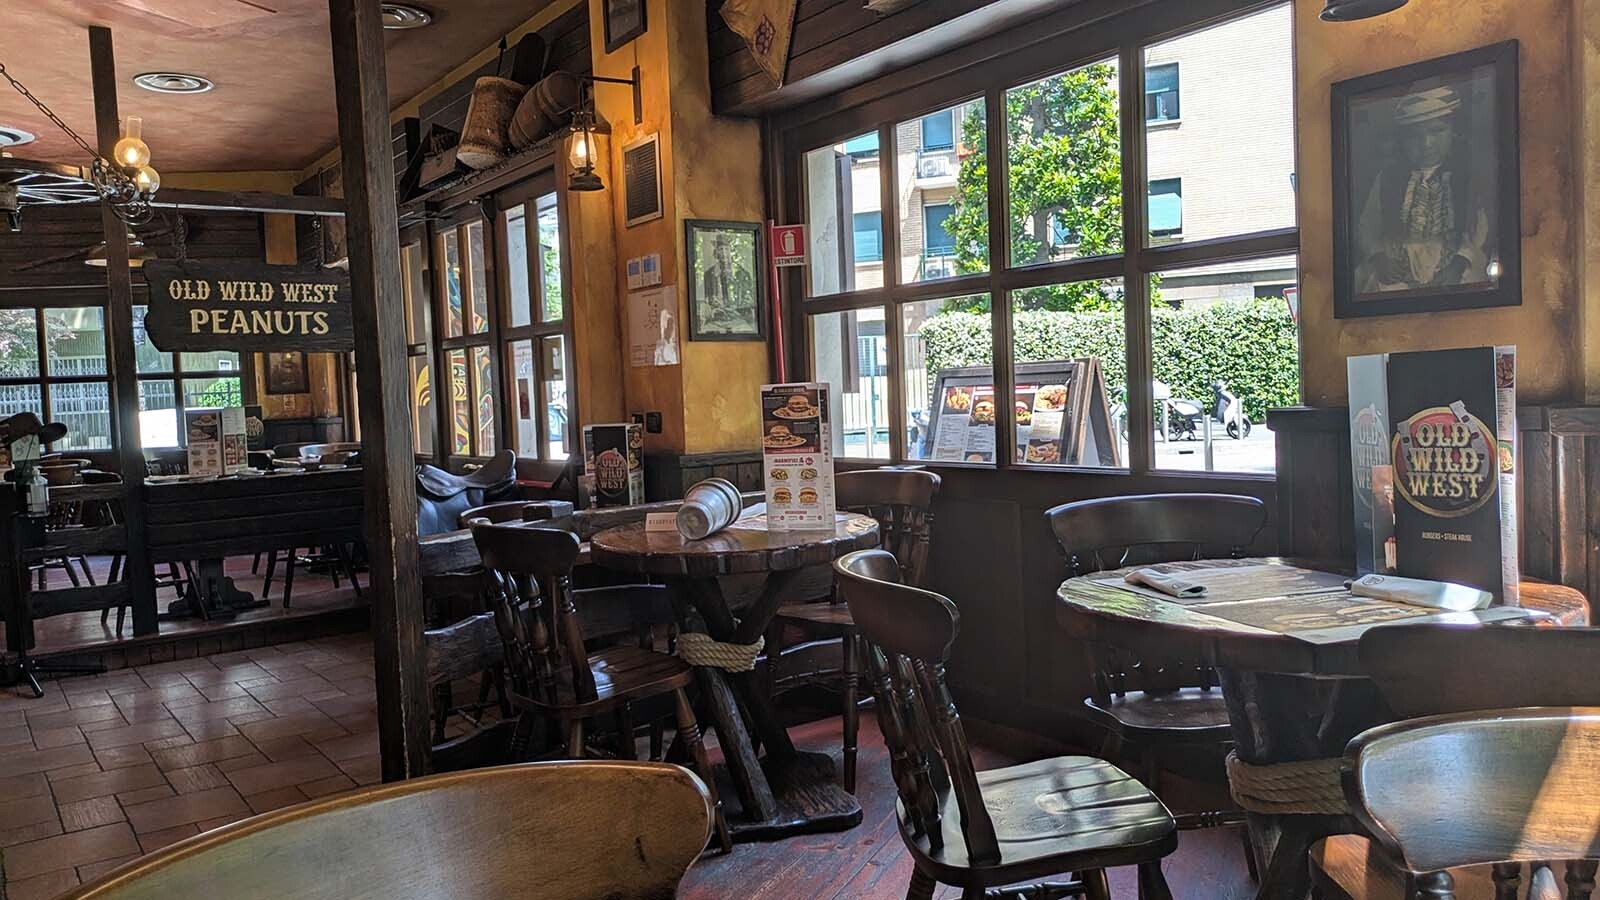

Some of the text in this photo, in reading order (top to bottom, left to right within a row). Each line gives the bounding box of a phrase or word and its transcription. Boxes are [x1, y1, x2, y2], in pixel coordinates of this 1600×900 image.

[169, 279, 338, 304] OLD WILD WEST
[190, 309, 329, 335] PEANUTS
[1416, 423, 1472, 447] OLD
[1409, 448, 1481, 473] WILD
[600, 479, 625, 489] WEST
[1406, 473, 1485, 498] WEST
